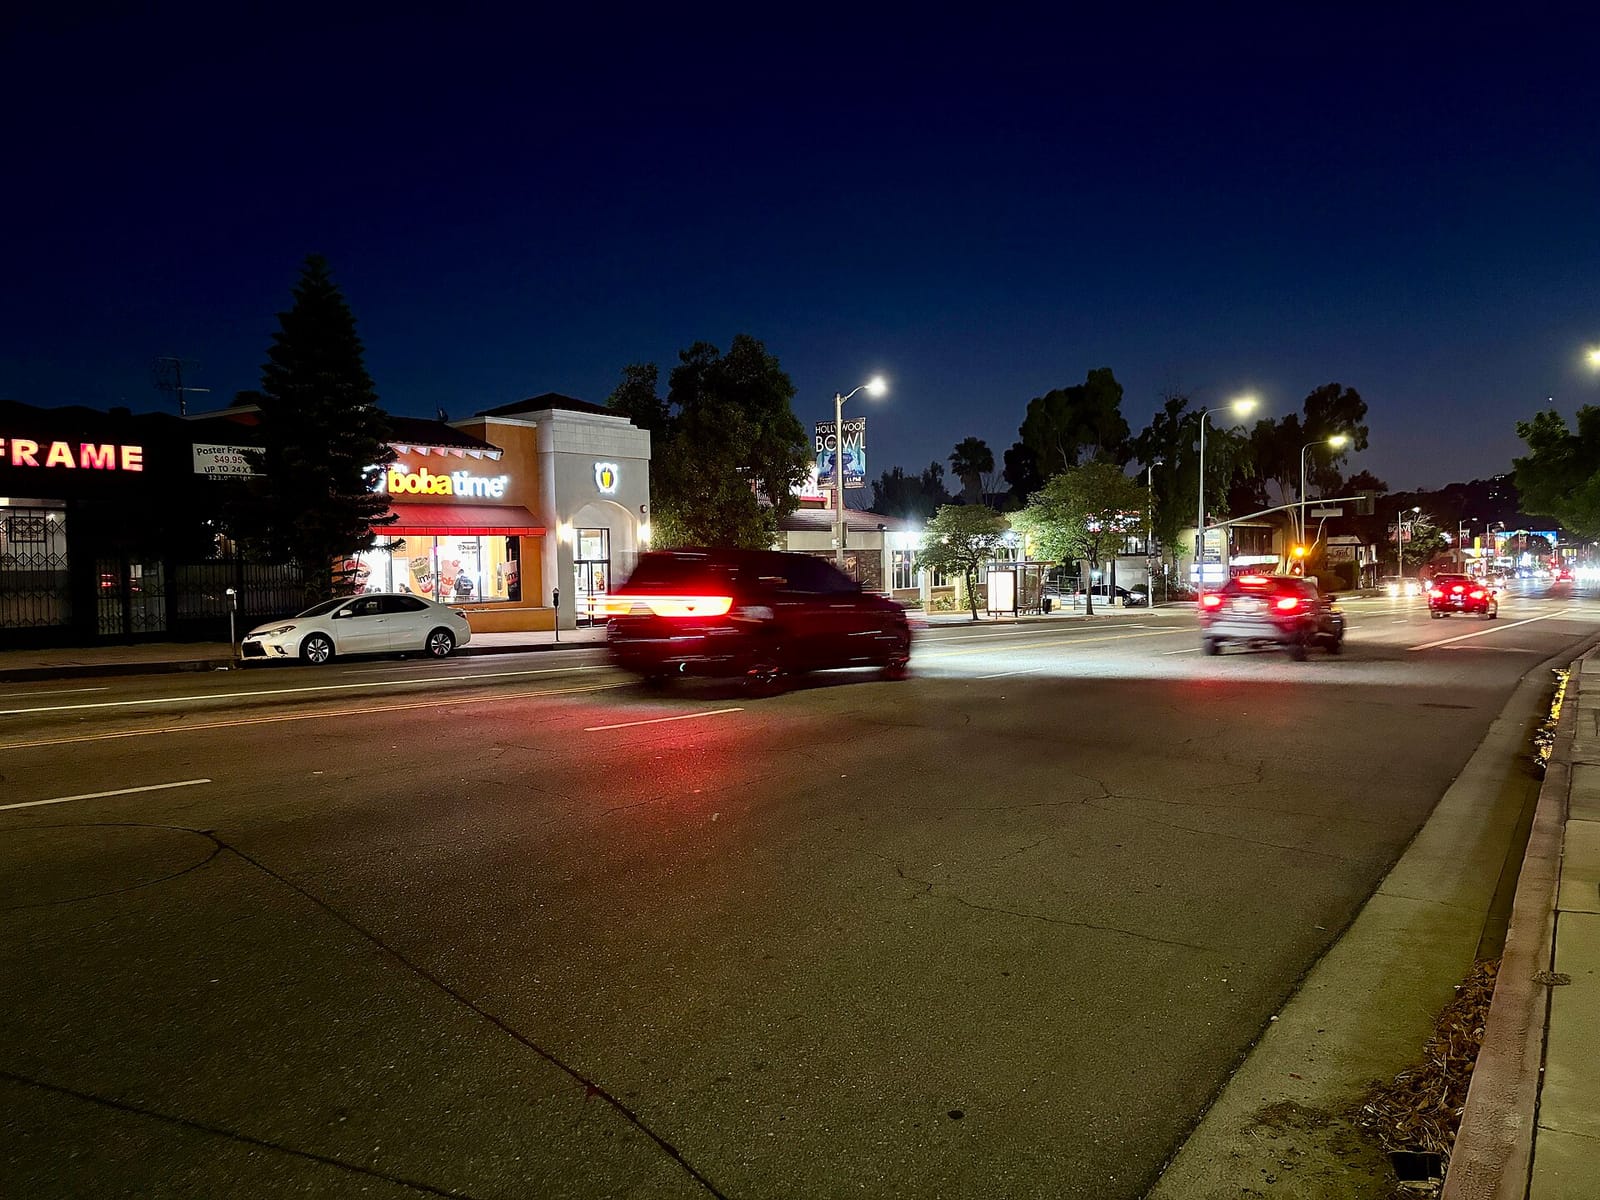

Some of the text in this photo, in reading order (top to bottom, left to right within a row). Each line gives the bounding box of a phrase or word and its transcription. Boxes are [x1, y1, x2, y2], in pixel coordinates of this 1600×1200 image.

[816, 432, 866, 452] BOWL
[0, 438, 143, 471] RAME
[196, 447, 226, 456] Poster
[214, 455, 243, 464] $49.95
[204, 465, 216, 473] UP
[218, 465, 229, 473] TO
